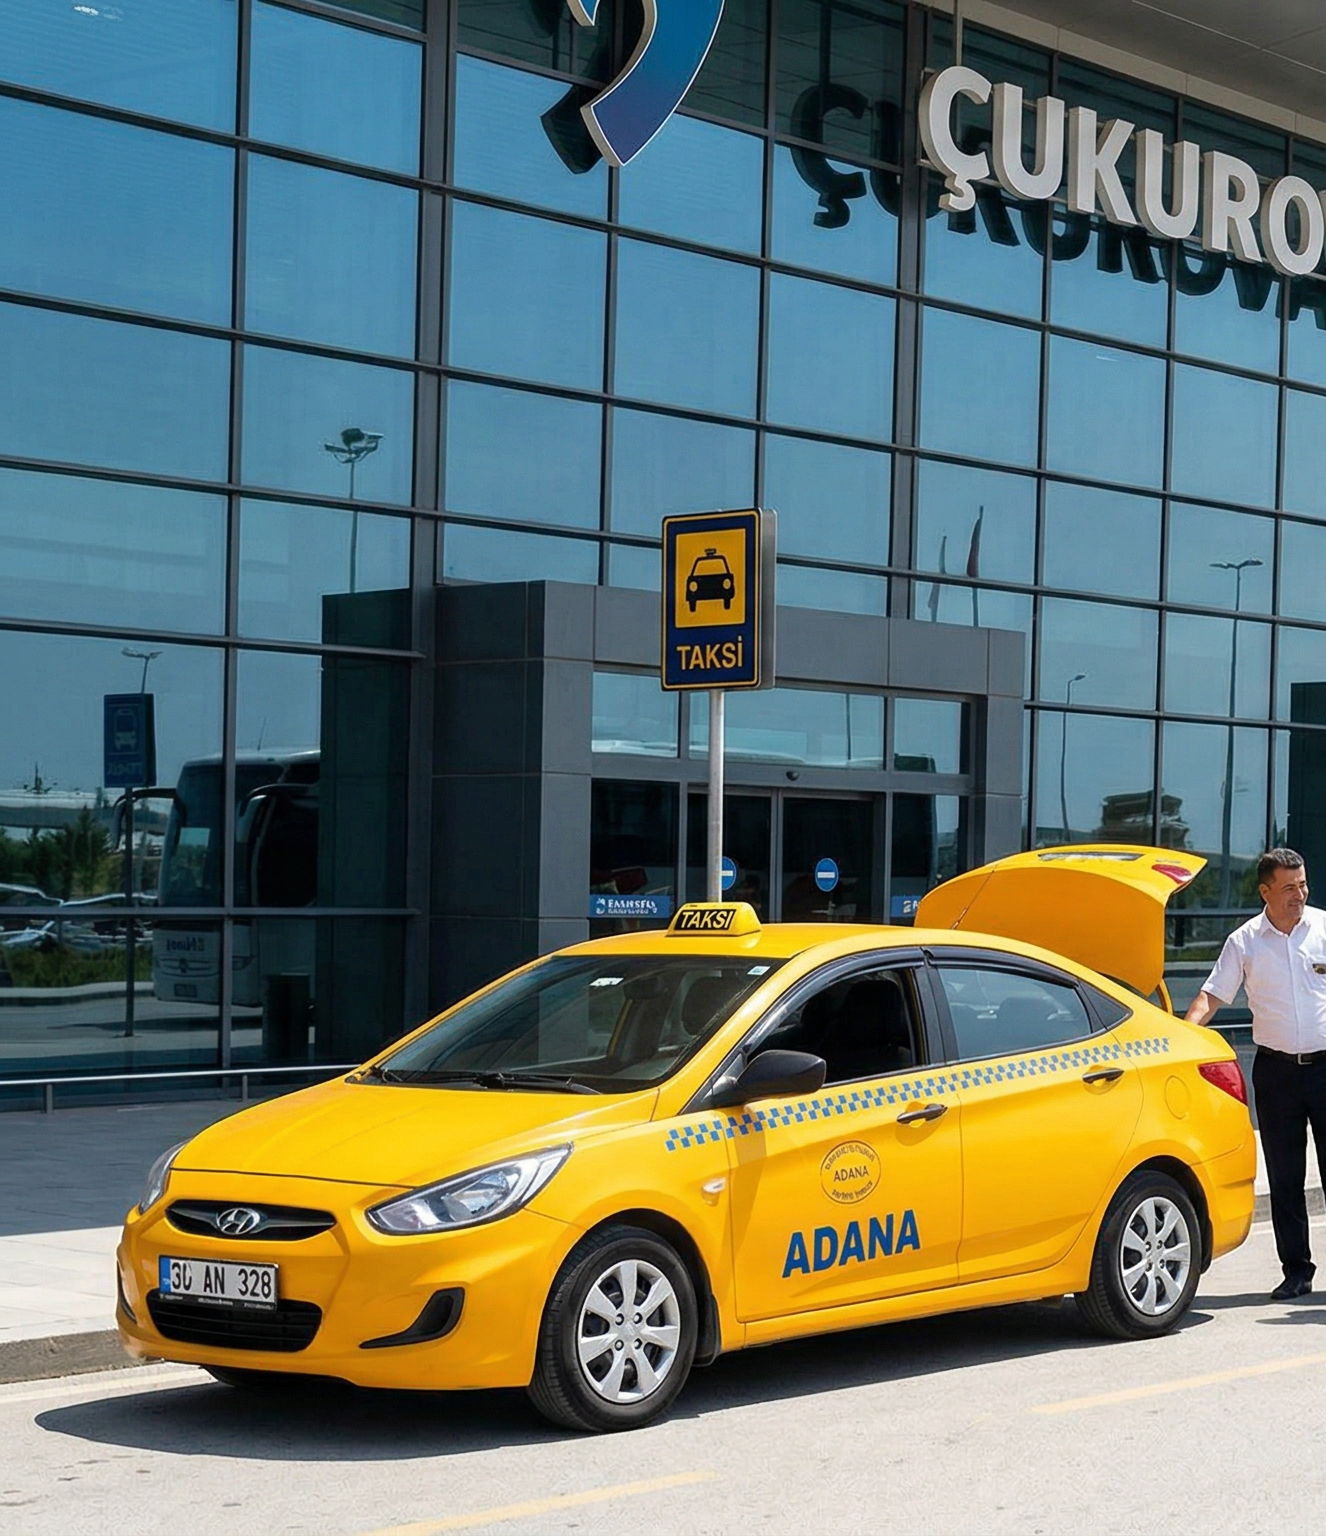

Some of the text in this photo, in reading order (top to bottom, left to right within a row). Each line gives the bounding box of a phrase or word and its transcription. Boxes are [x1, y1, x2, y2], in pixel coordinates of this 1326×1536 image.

[676, 635, 743, 670] TAKSİ
[680, 911, 734, 928] TAKSI
[834, 1165, 870, 1182] ADANA
[782, 1209, 921, 1278] ADANA
[203, 1265, 225, 1295] AN
[237, 1268, 272, 1299] 328
